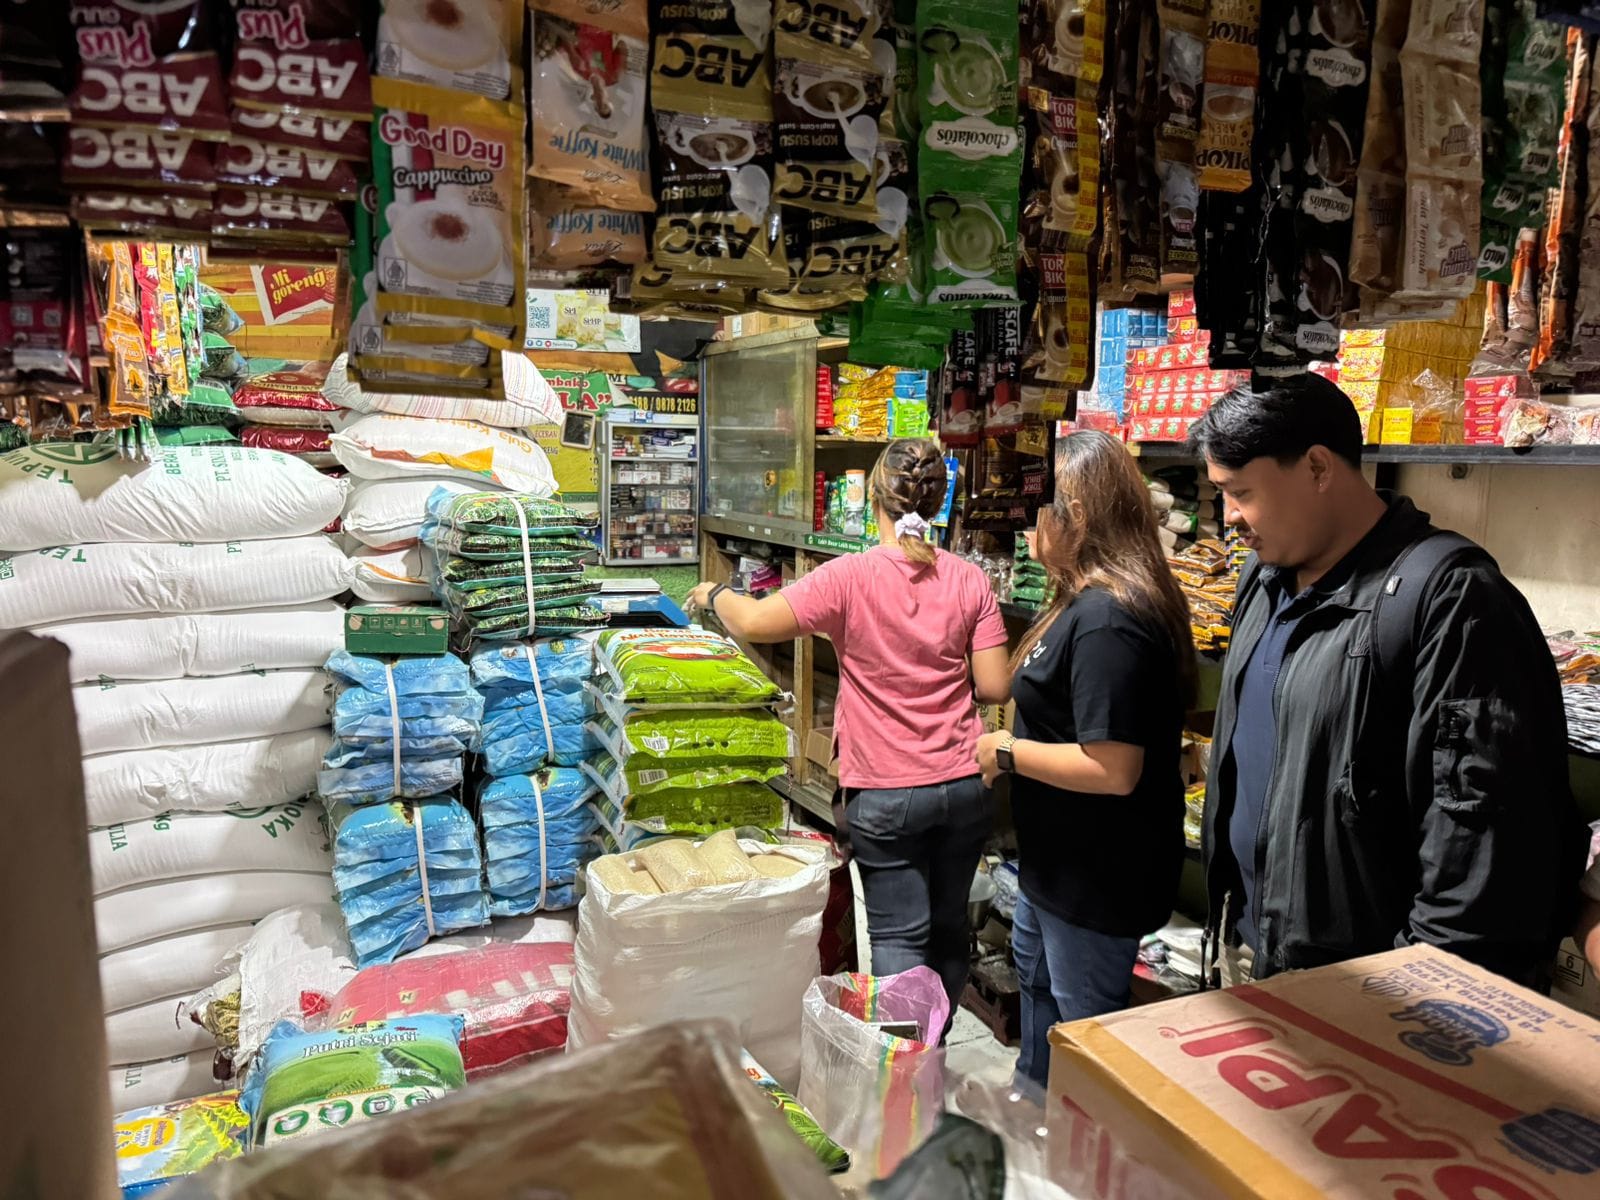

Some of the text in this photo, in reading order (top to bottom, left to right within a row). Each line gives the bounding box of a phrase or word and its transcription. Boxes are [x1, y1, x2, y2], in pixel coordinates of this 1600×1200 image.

[237, 5, 310, 49] Plus
[780, 0, 867, 48] ABC
[77, 27, 155, 67] Plus
[235, 50, 358, 100] ABC
[659, 38, 764, 88] ABC
[80, 68, 210, 118] ABC
[1052, 102, 1077, 116] TOR
[1054, 116, 1077, 130] BIK
[69, 128, 196, 171] ABC
[380, 115, 504, 169] Good Day
[549, 130, 648, 172] White Koffie
[779, 134, 838, 147] KOPI SUSU
[225, 139, 339, 181] ABC
[393, 166, 493, 192] Cappuccino
[661, 184, 697, 200] SUSU
[780, 164, 871, 205] ABC
[220, 191, 330, 223] ABC
[546, 210, 641, 234] White Koffie
[660, 217, 760, 260] ABC
[807, 244, 899, 277] ABC
[1041, 257, 1064, 270] TOR
[1483, 249, 1506, 264] MILO
[270, 268, 291, 290] Mi
[273, 269, 327, 305] goreng
[1044, 271, 1065, 284] BIK
[656, 397, 676, 411] 0878
[677, 398, 697, 413] 2126
[499, 432, 533, 454] Gula
[1402, 963, 1441, 984] 490g
[1565, 955, 1575, 970] 6
[1452, 978, 1497, 1001] Kental
[1457, 989, 1519, 1022] Kaleng
[303, 1031, 418, 1058] Putri Sejati
